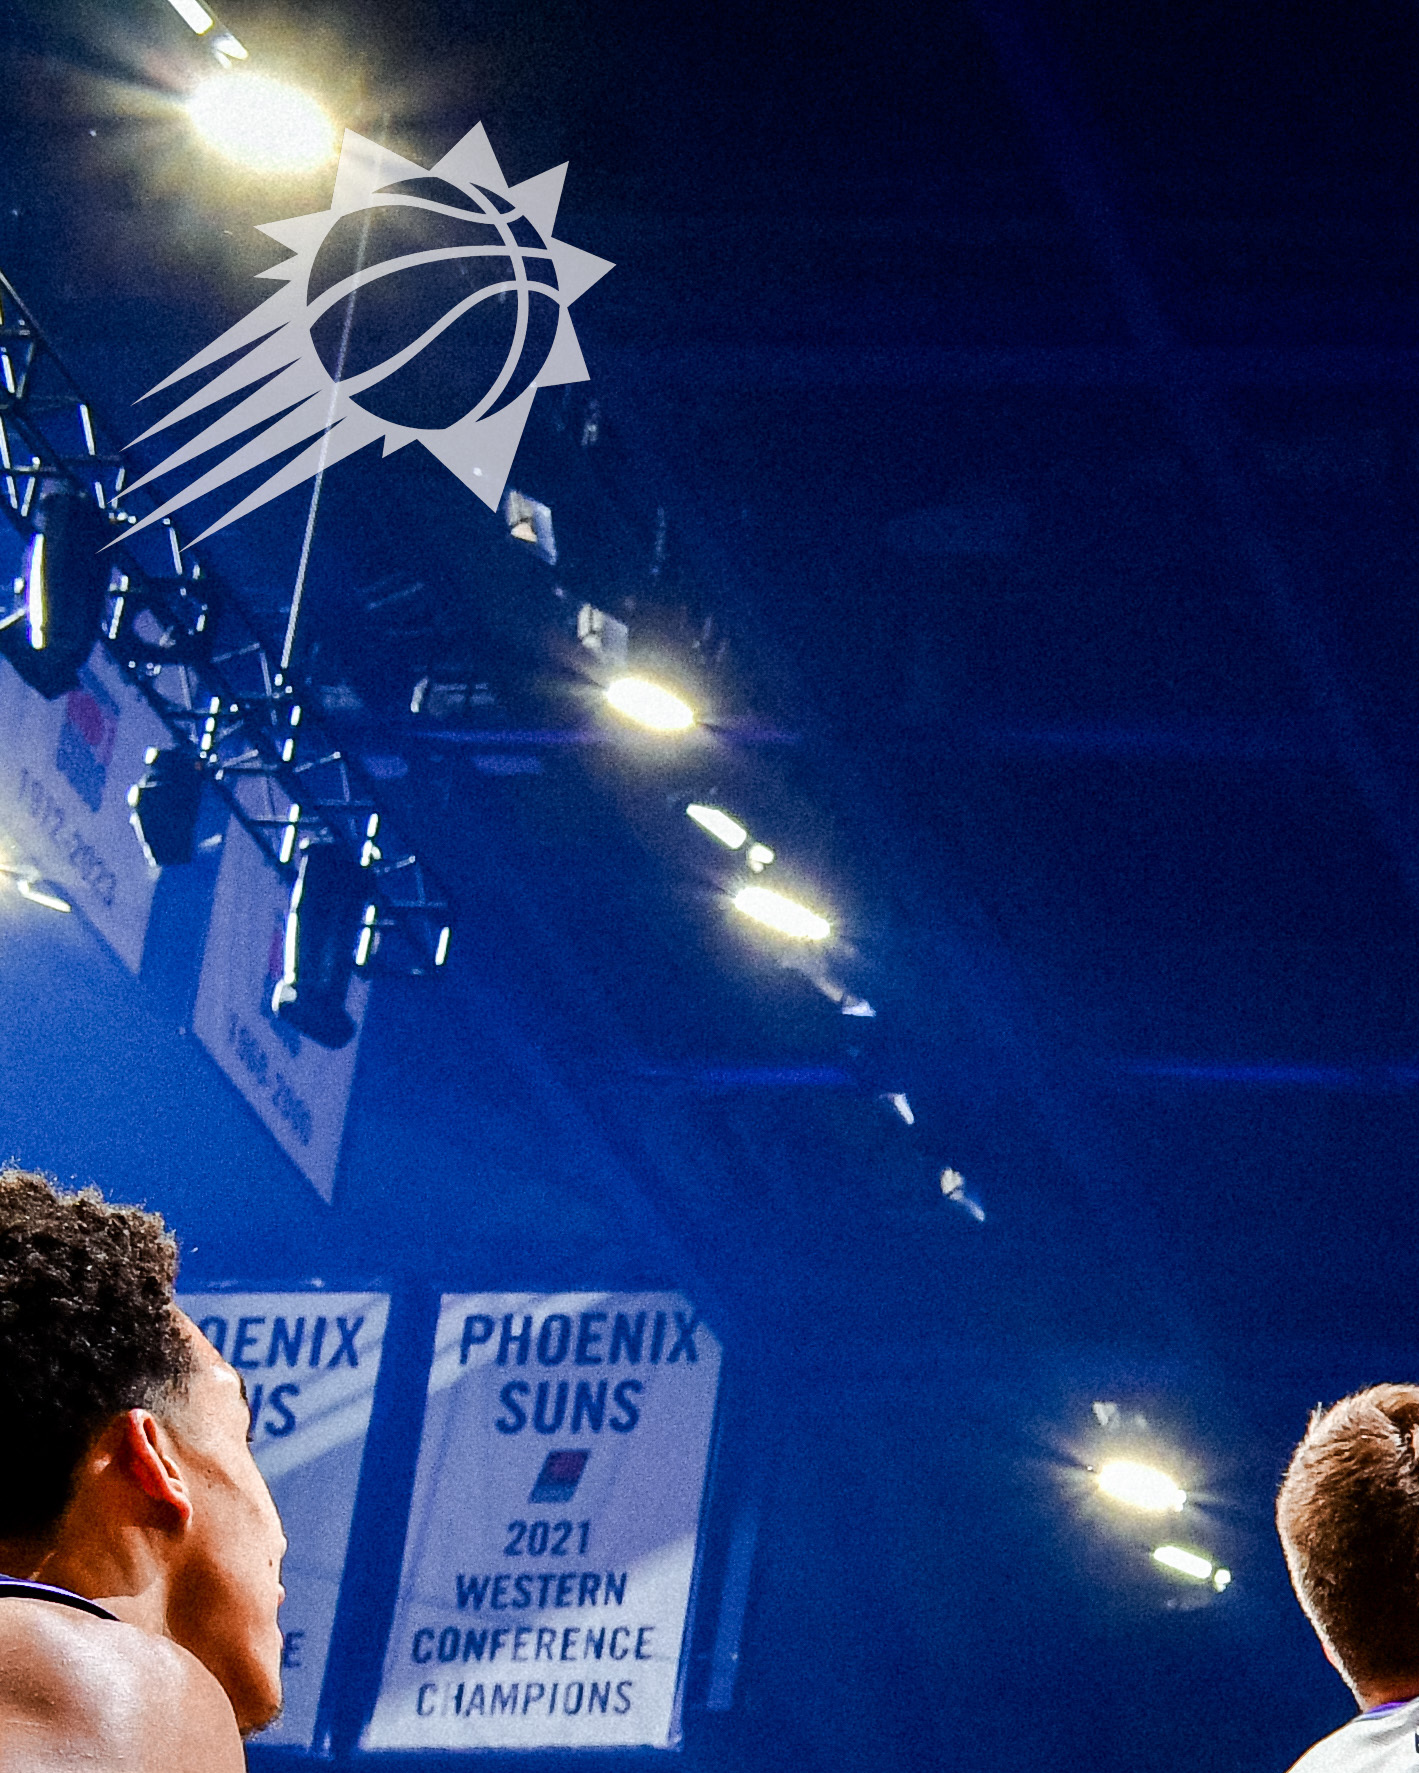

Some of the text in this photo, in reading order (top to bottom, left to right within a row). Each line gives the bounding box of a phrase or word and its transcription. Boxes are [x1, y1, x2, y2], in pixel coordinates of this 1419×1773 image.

[459, 1312, 701, 1366] PHOENIX
[494, 1379, 644, 1435] SUNS
[504, 1519, 591, 1558] 2021
[456, 1571, 628, 1610] WESTERN
[412, 1625, 656, 1664] CONFERENCE
[416, 1680, 634, 1717] CHAMPIONS
